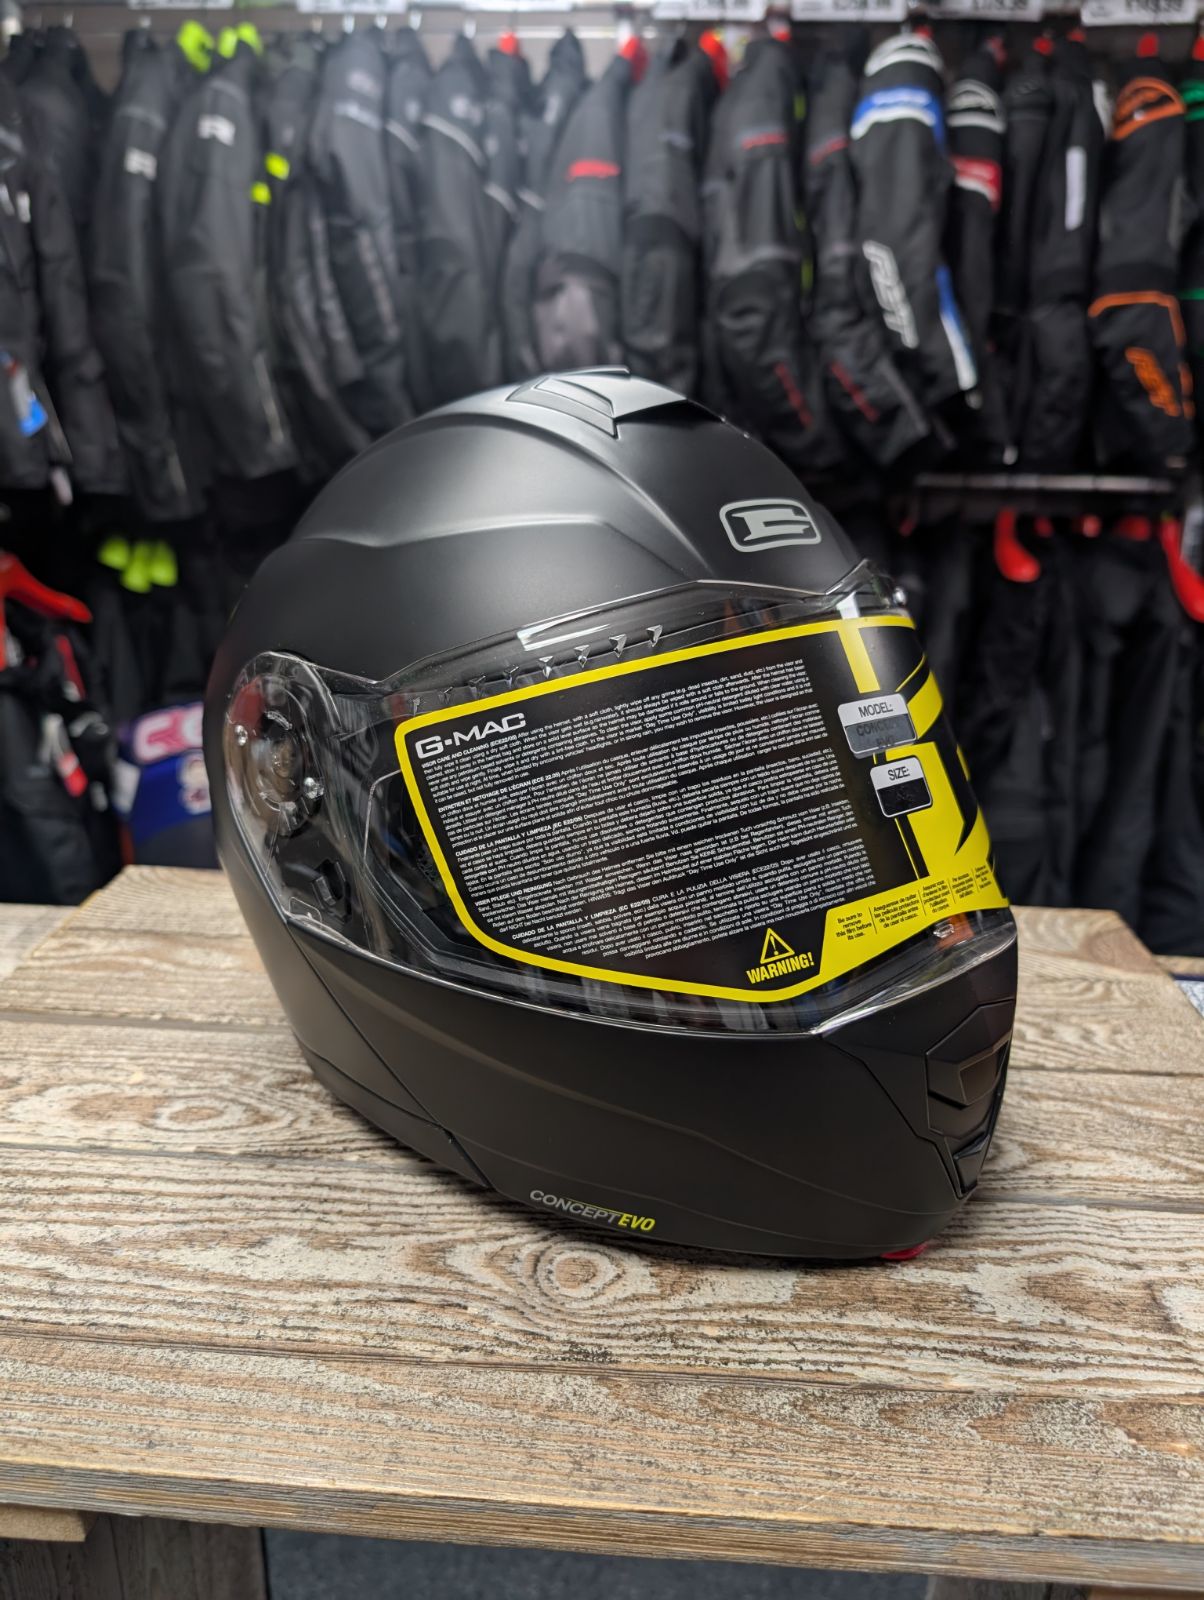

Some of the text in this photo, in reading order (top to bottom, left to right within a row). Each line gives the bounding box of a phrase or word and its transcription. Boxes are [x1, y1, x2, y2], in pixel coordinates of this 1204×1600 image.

[642, 700, 661, 710] always
[669, 693, 685, 703] wiped
[858, 702, 893, 718] MODEL:
[435, 754, 451, 763] CARE
[462, 742, 489, 755] CLEANING
[887, 765, 911, 781] SIZE:
[493, 833, 520, 844] PANTALLA
[525, 824, 551, 835] LIMPIEZA
[511, 929, 535, 939] CUIDADO
[555, 917, 582, 927] PANTALLA
[589, 907, 616, 918] LIMPIEZA
[651, 893, 669, 901] CURA
[685, 882, 707, 892] PULIZIA
[708, 876, 727, 885] DELLA
[843, 920, 861, 929] remove
[856, 922, 872, 931] before
[746, 952, 814, 984] WARNING!
